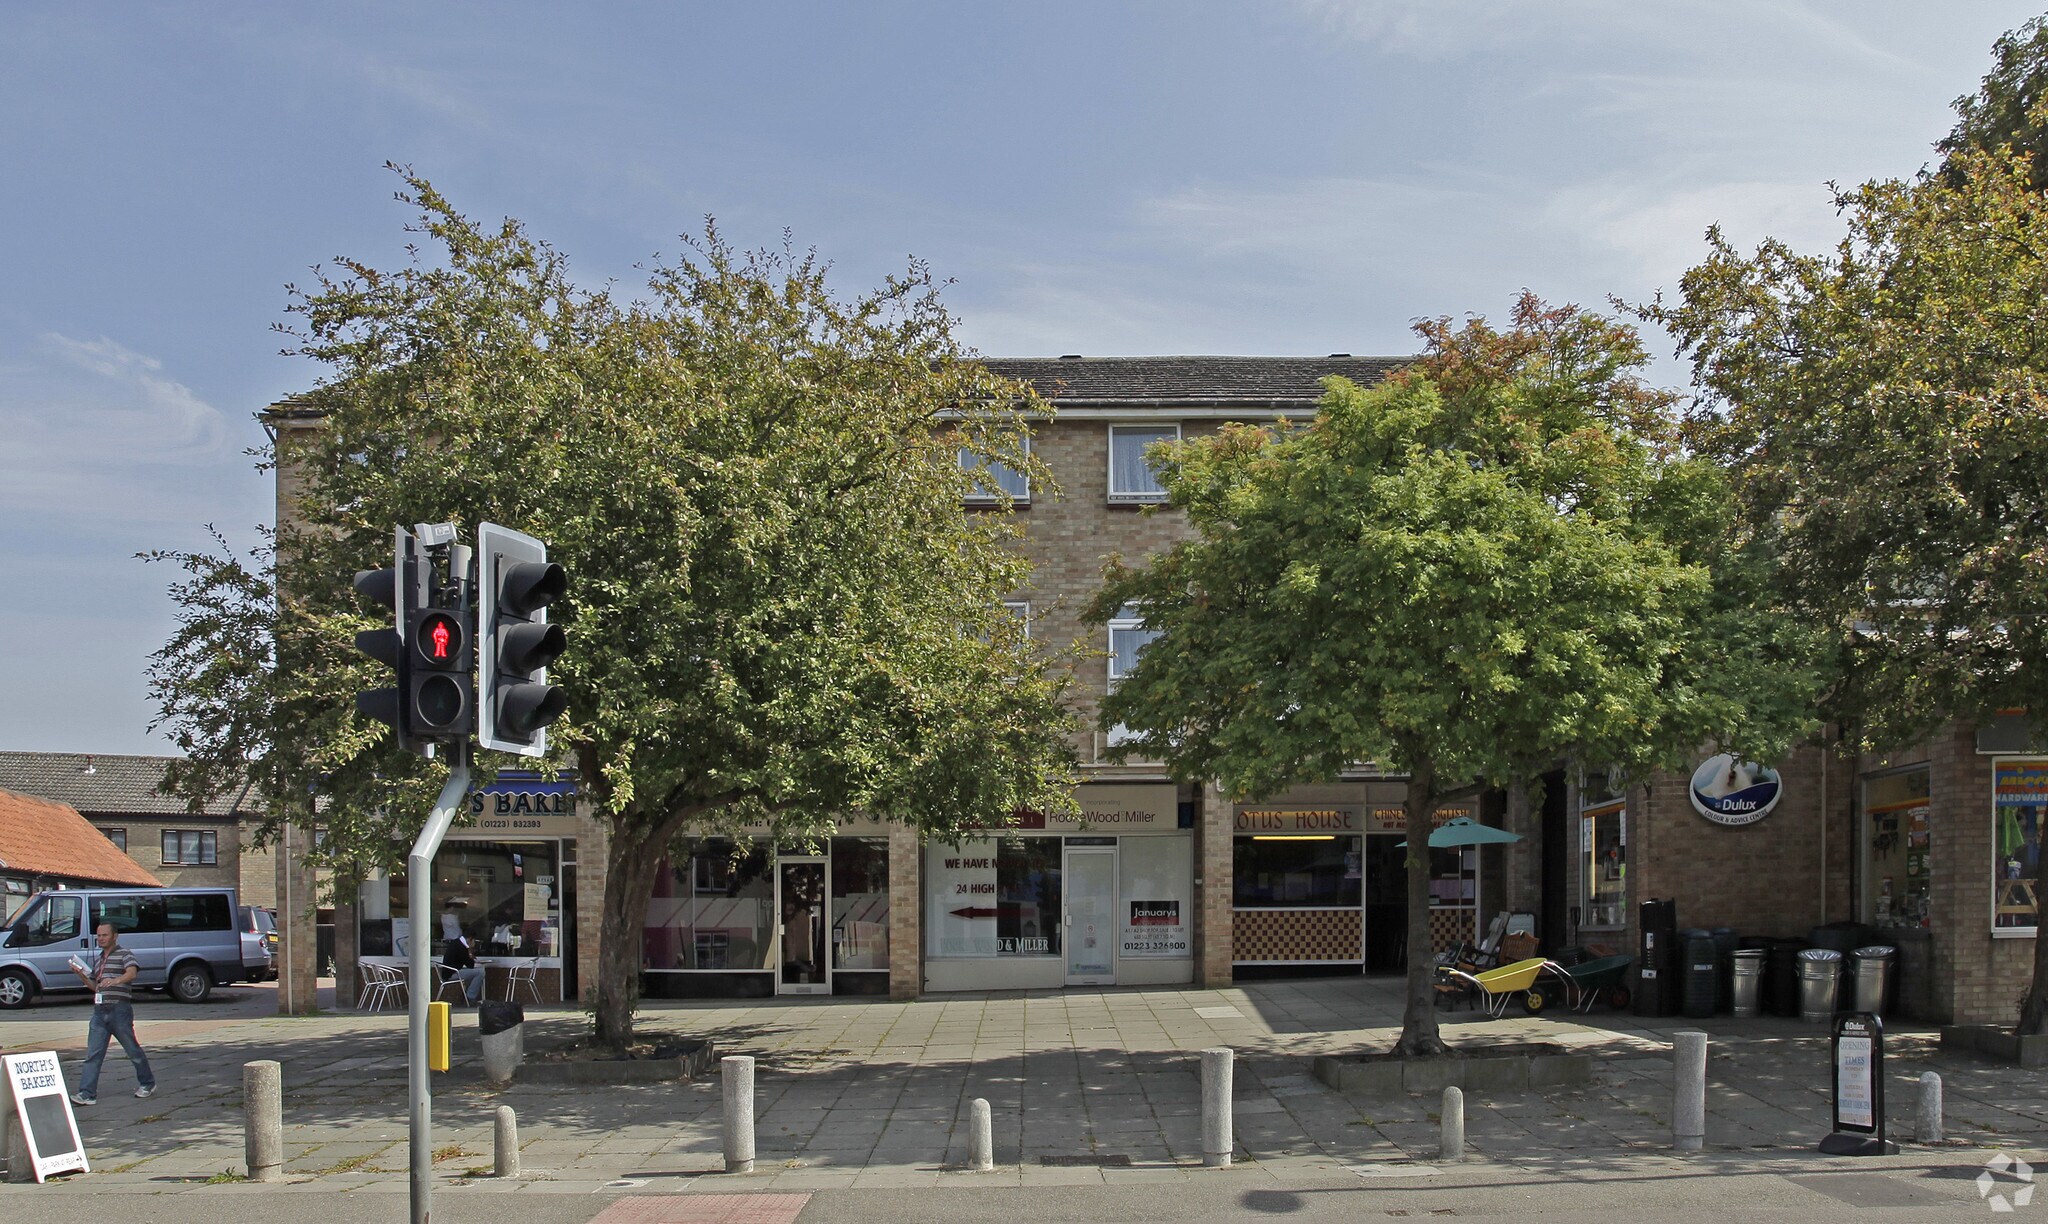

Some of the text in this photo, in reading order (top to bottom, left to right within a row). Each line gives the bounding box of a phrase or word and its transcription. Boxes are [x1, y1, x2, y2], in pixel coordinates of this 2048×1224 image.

[1722, 799, 1756, 811] Dulux
[1125, 810, 1155, 823] Miller
[1296, 811, 1352, 829] HOUSE
[1704, 810, 1724, 822] COLOUR
[1731, 816, 1748, 824] ADVICE
[1749, 809, 1768, 821] CENTRE
[481, 819, 510, 828] (01223)
[944, 858, 960, 869] WE
[963, 858, 988, 869] HAVE
[956, 884, 967, 894] 24
[971, 884, 995, 893] HIGH
[1133, 907, 1177, 919] Januarys
[1005, 941, 1012, 951] &
[1015, 937, 1049, 954] MILLER
[1124, 942, 1186, 950] 01223 326800
[1849, 1021, 1865, 1030] Dulux
[1840, 1040, 1870, 1050] OPENING
[15, 1059, 55, 1074] NORTH'S
[1844, 1056, 1865, 1065] TIMES
[20, 1075, 56, 1090] BAKERY
